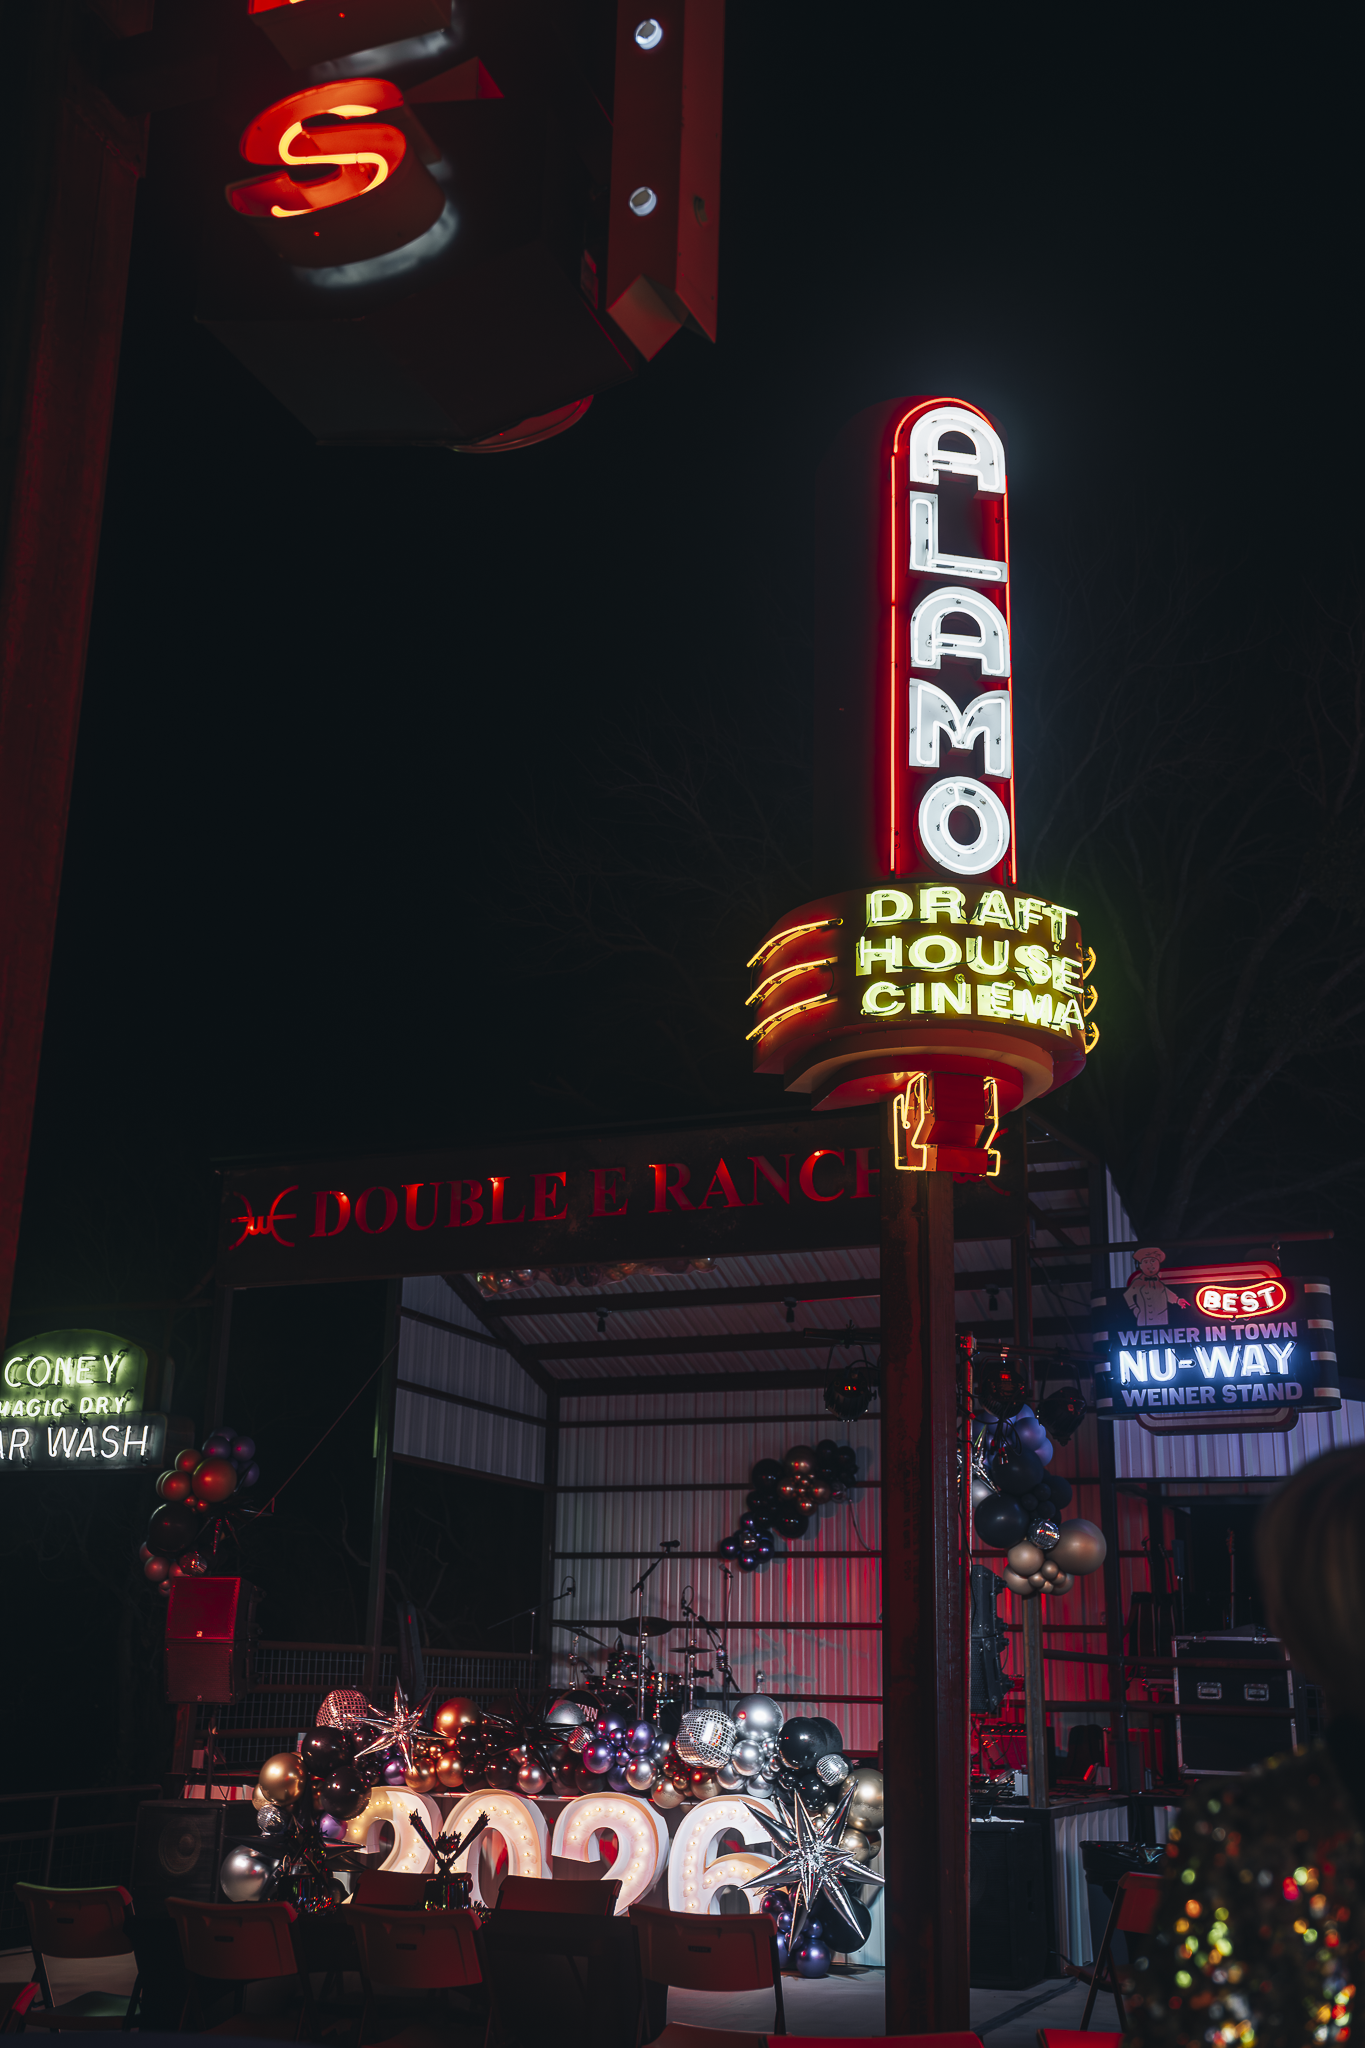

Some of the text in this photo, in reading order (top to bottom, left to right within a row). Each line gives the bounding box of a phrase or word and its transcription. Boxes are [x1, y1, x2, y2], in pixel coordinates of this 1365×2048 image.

[908, 406, 1010, 876] ALAMO
[864, 885, 1079, 943] DRAFT
[855, 934, 1084, 995] HOUSE
[860, 980, 1086, 1037] CINEMA
[308, 1171, 568, 1238] DOUBLE
[588, 1166, 629, 1218] E
[1203, 1286, 1276, 1312] BEST
[1118, 1321, 1298, 1347] WEINER IN TOWN
[4, 1354, 121, 1388] CONEY
[1118, 1341, 1297, 1386] NU-WAY
[79, 1396, 127, 1415] DRY
[1121, 1381, 1303, 1407] WEINER STAND
[47, 1424, 149, 1459] WASH
[340, 1786, 780, 1916] 2026
